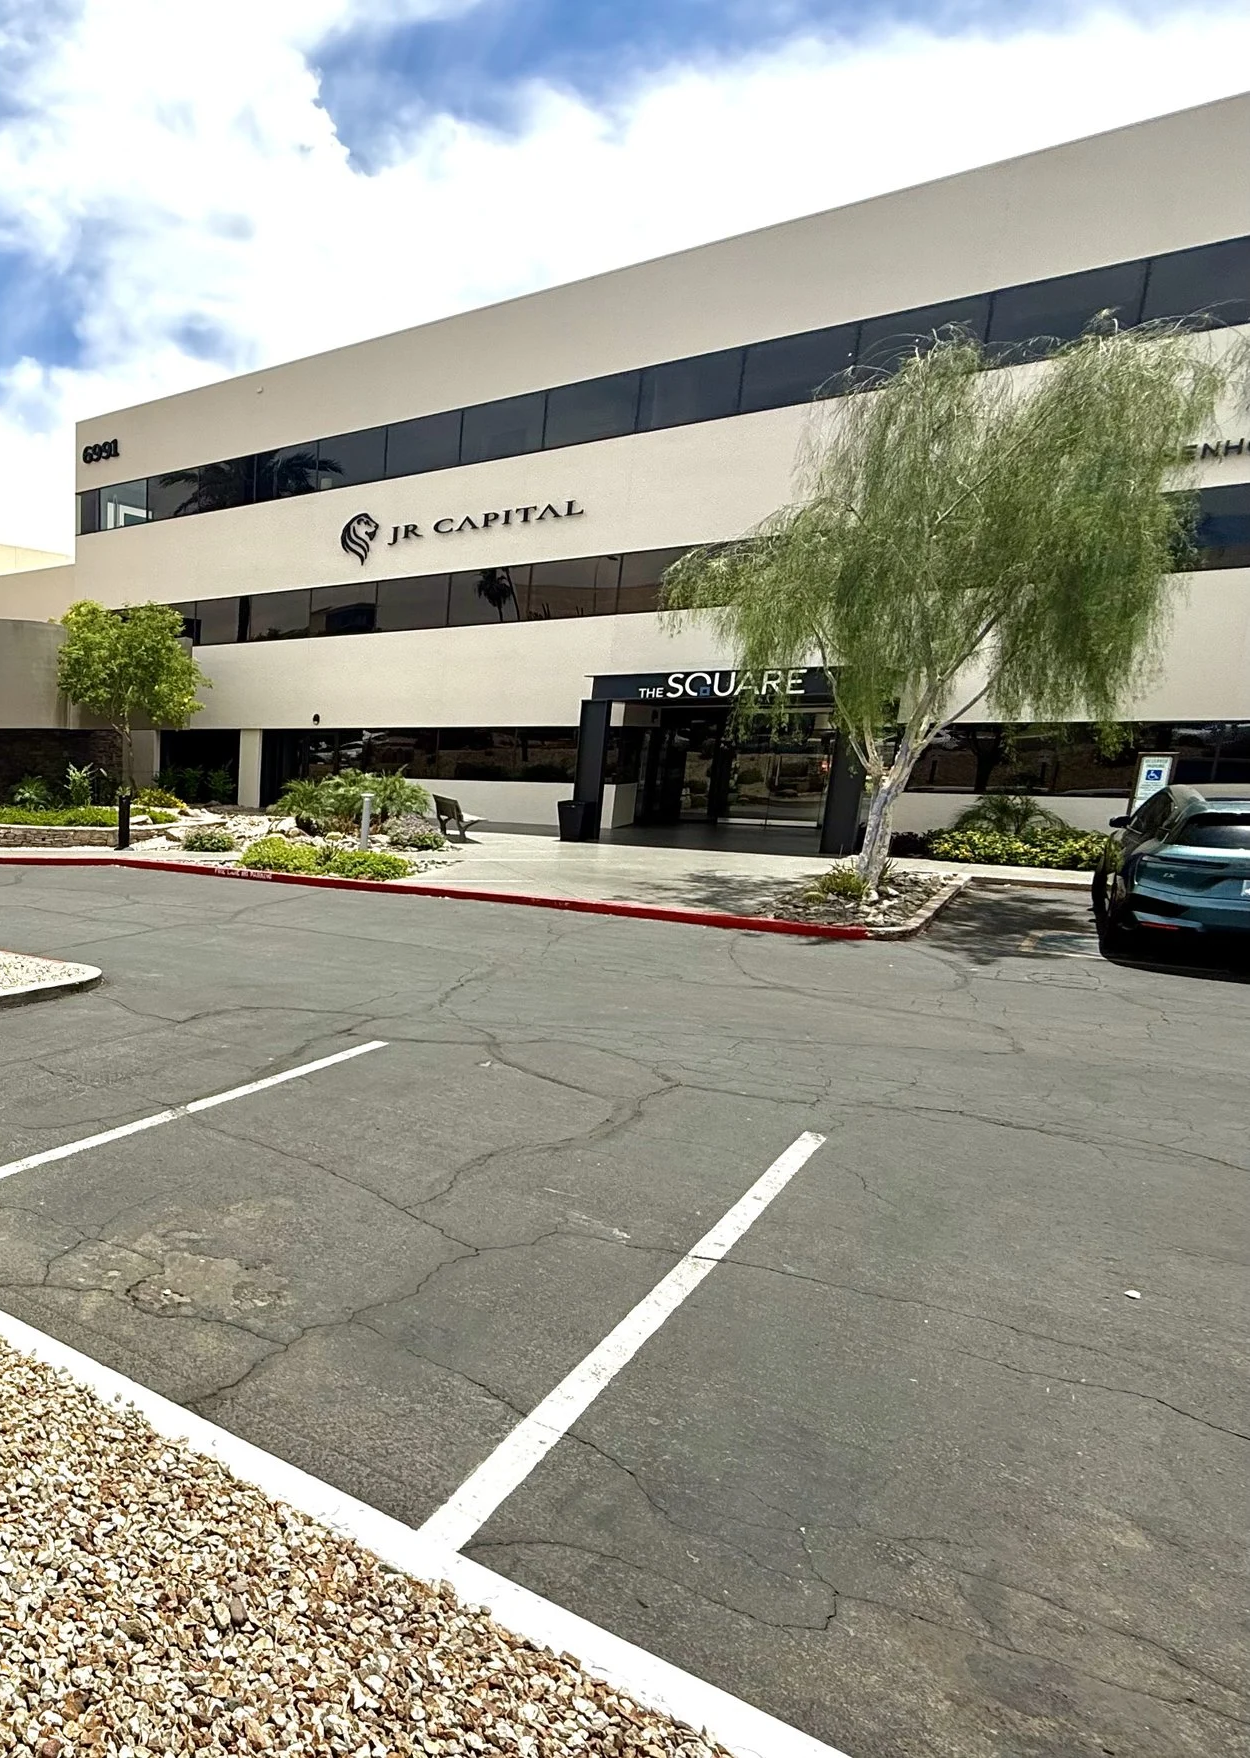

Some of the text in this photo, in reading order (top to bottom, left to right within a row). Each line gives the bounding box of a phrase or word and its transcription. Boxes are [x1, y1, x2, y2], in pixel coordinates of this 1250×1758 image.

[82, 438, 120, 464] 6991
[387, 499, 584, 546] JR CAPITAL
[638, 668, 808, 699] THE SQUARE
